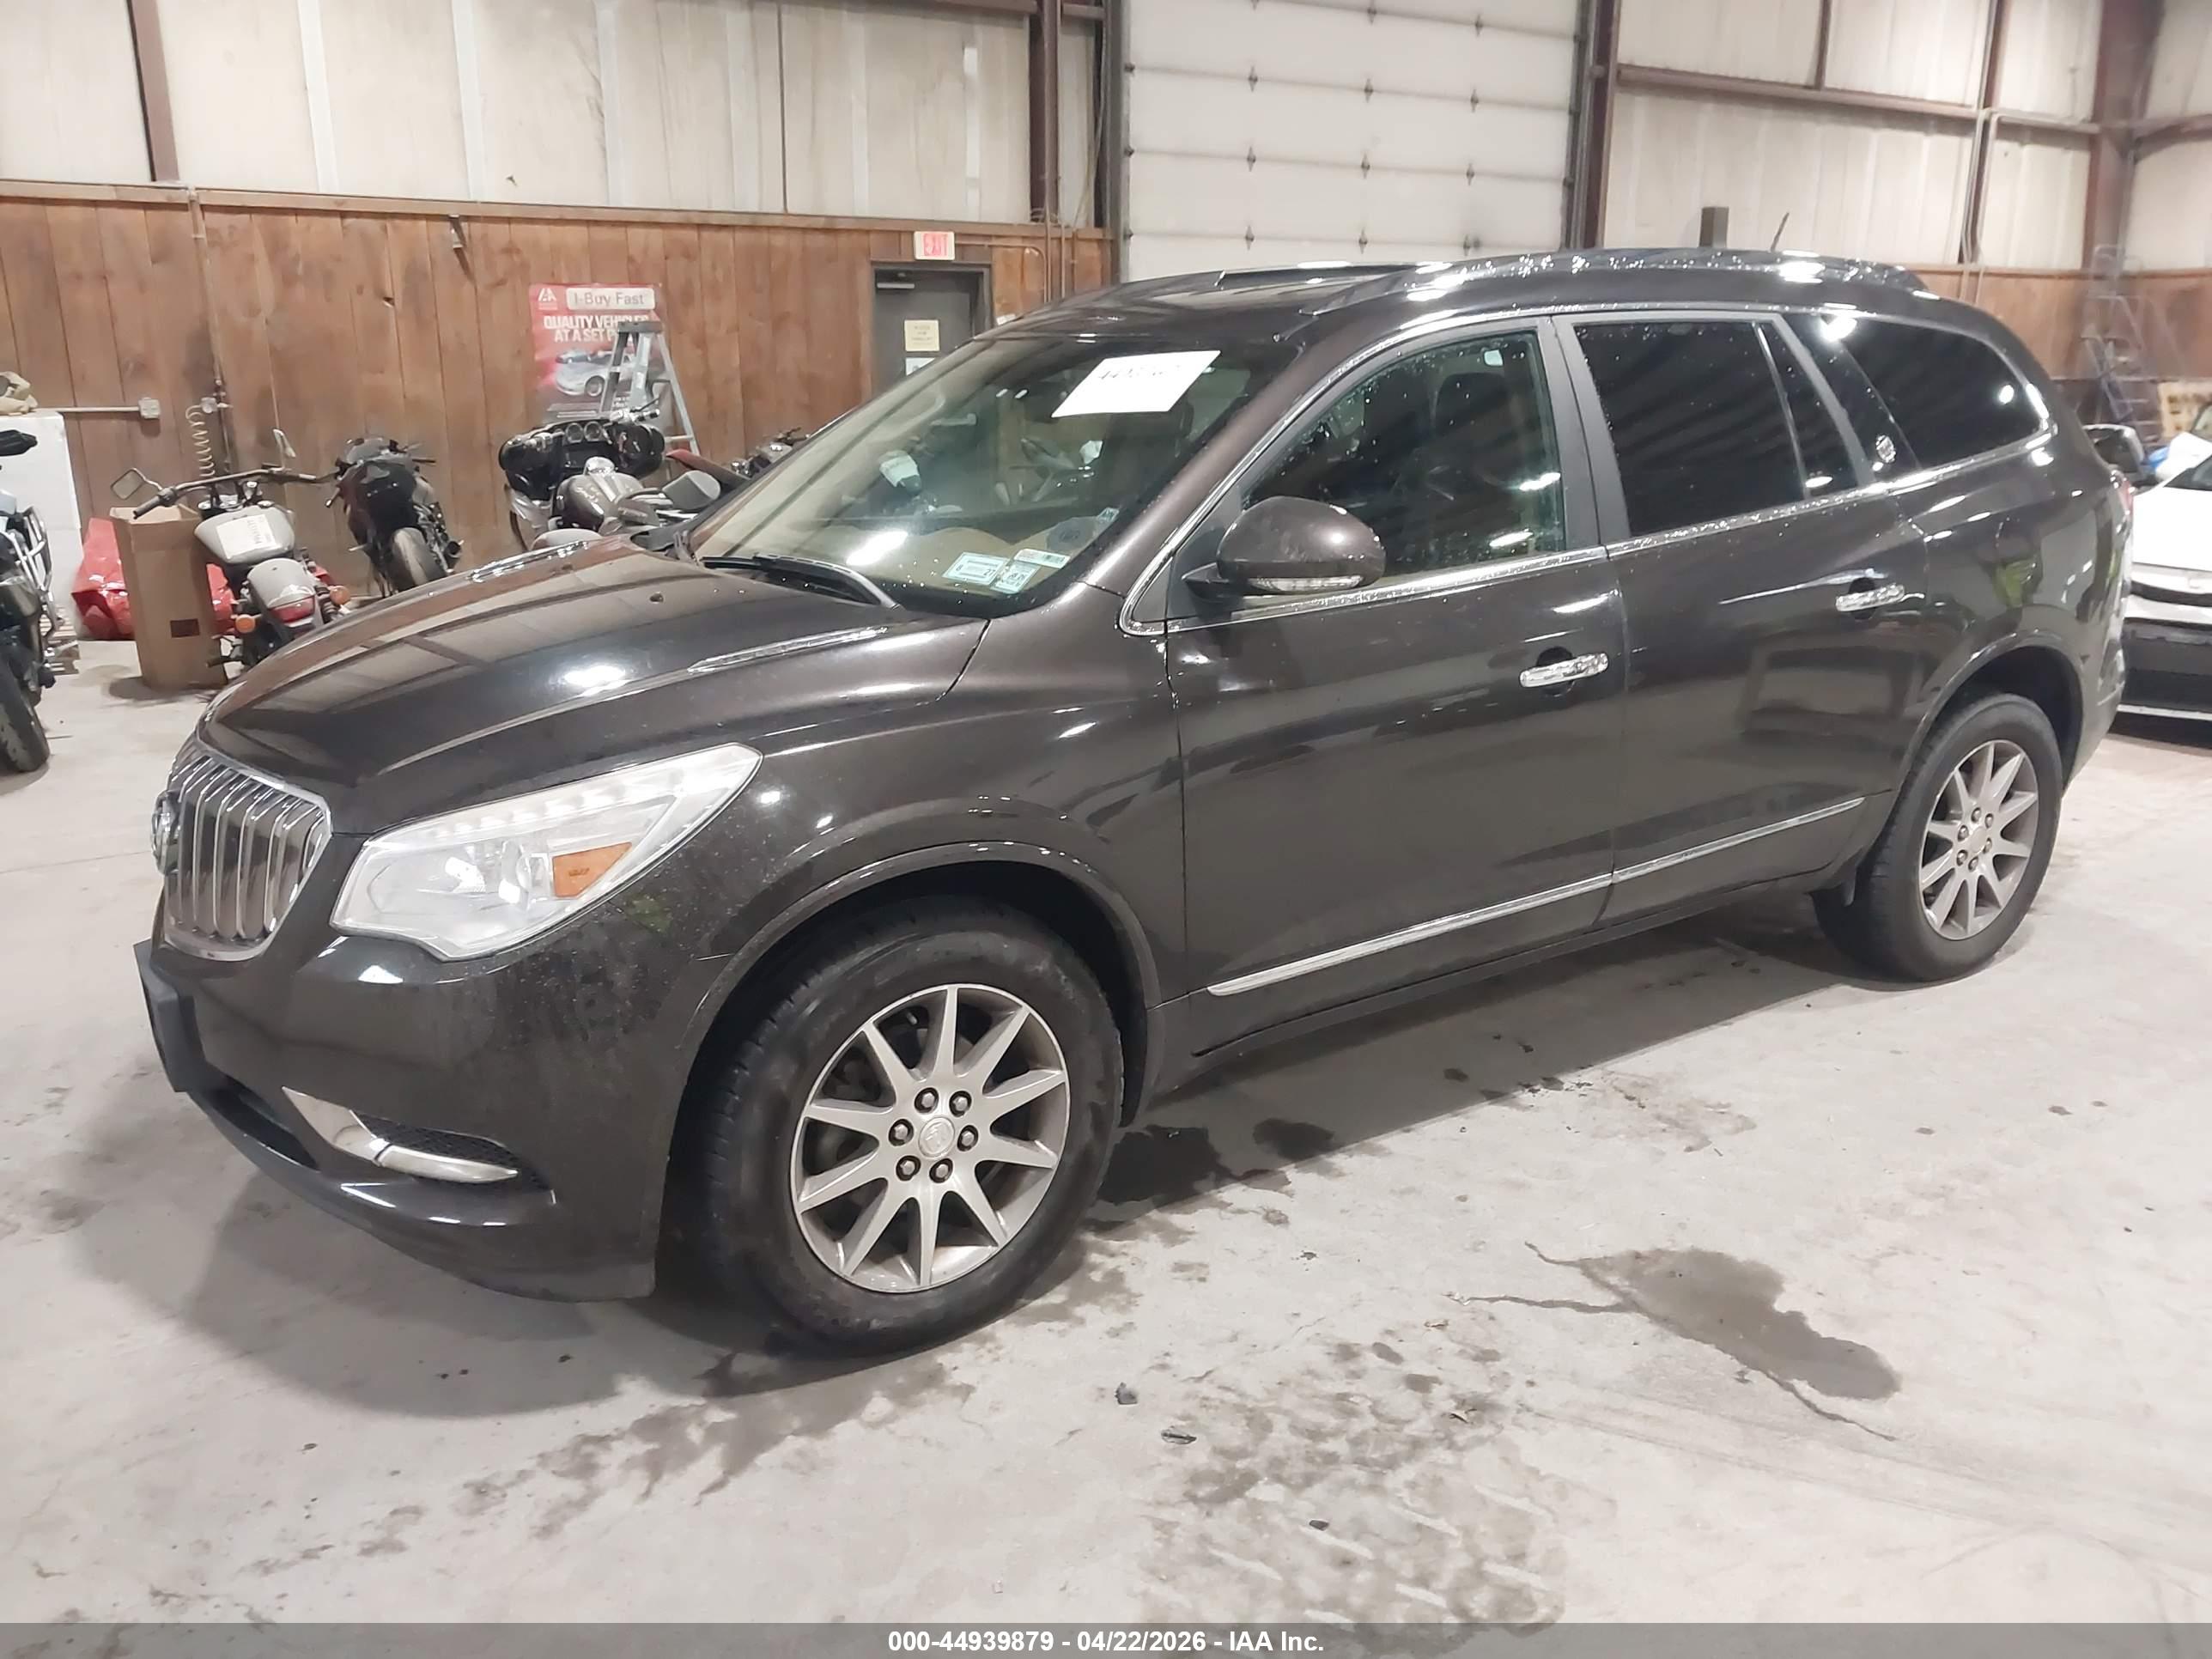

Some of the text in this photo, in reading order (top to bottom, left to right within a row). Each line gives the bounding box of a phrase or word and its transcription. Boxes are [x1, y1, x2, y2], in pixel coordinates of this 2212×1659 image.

[923, 233, 948, 257] EXIT
[574, 292, 611, 307] I-Buy
[616, 292, 645, 305] Fast
[544, 315, 592, 329] QUALITY
[555, 329, 570, 343] AT
[573, 329, 581, 342] A
[584, 329, 605, 342] SET
